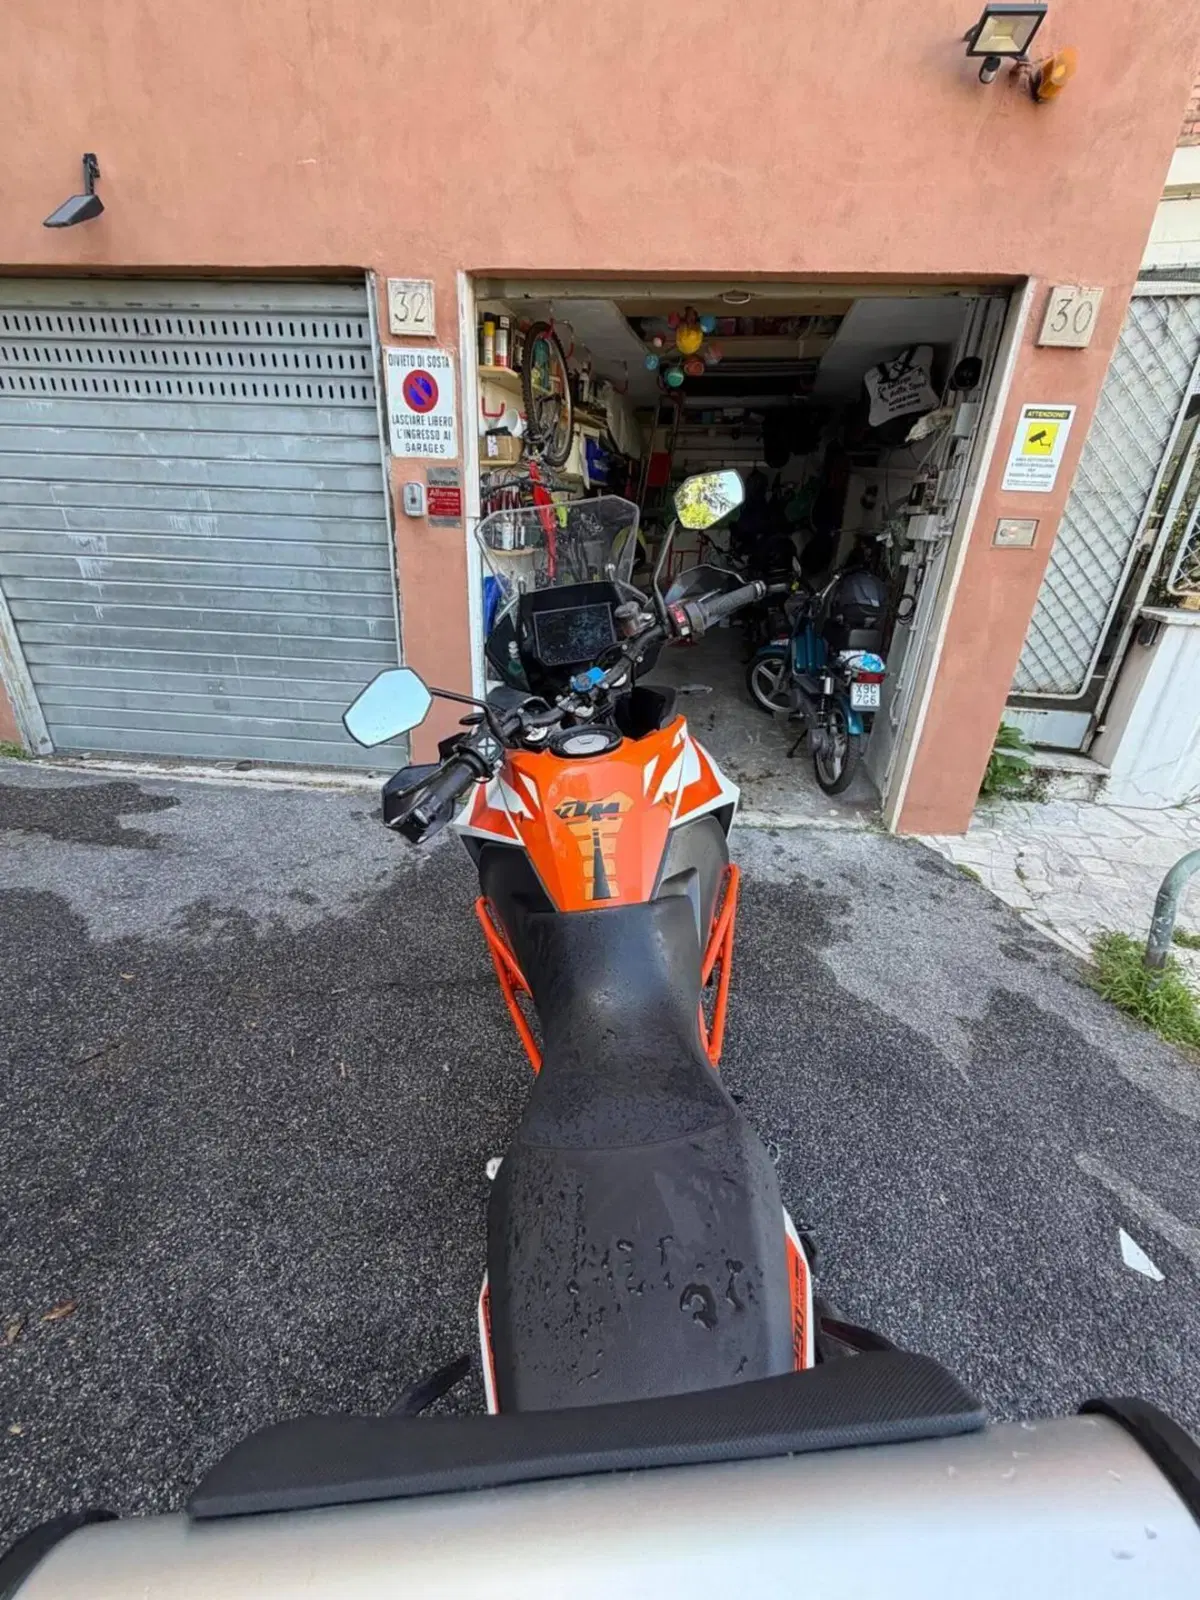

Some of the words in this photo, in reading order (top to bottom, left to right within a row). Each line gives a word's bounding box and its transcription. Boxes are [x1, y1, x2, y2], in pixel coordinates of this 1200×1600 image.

[394, 291, 426, 322] 32
[1051, 298, 1093, 334] 30
[388, 353, 415, 367] DIVIETO
[417, 355, 425, 368] DI
[427, 356, 450, 368] SOSTA
[392, 414, 425, 426] LASCIARE
[428, 415, 453, 427] LIBERO
[396, 428, 440, 441] L'INGRESSO
[444, 431, 451, 441] AI
[405, 442, 445, 454] GARAGES
[856, 683, 877, 694] X9C
